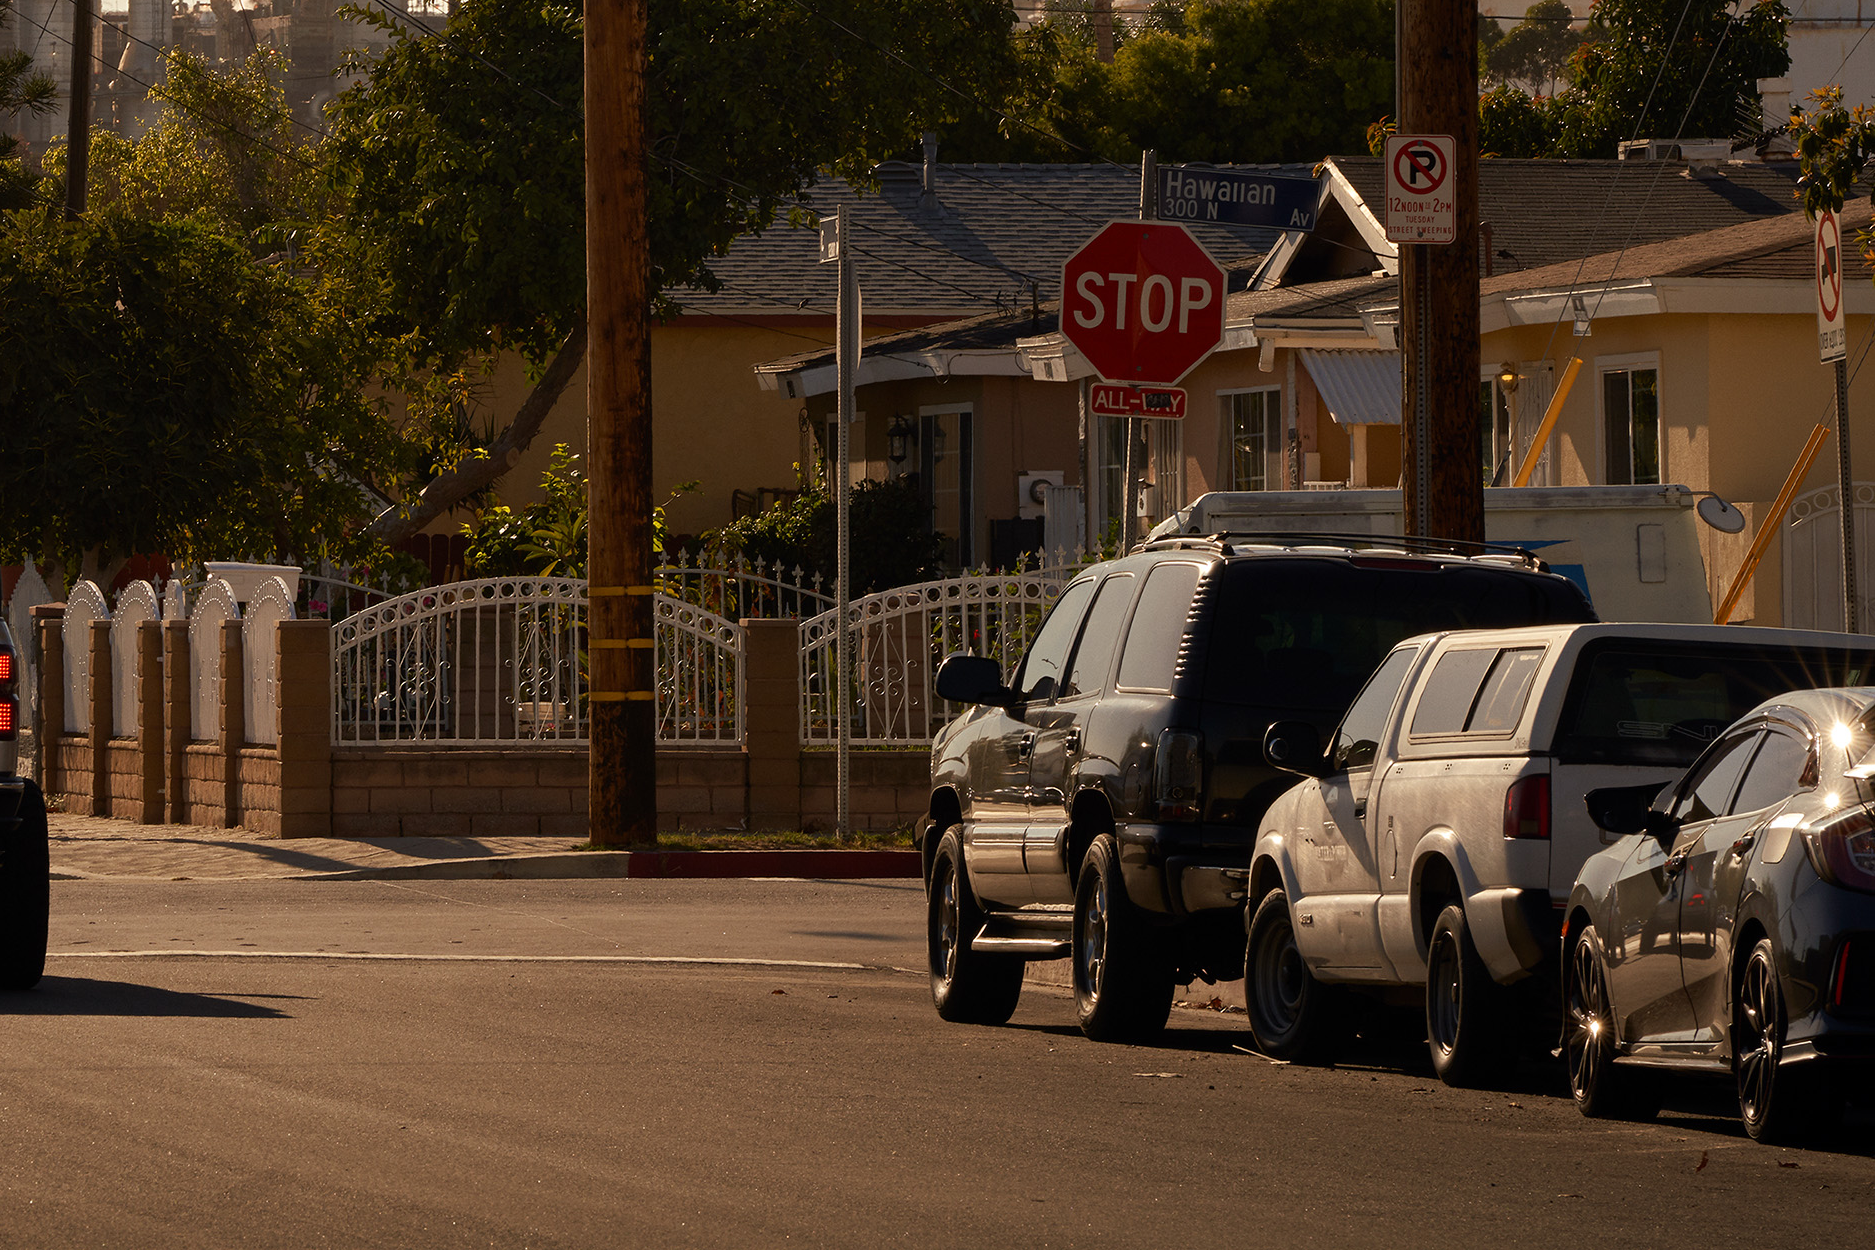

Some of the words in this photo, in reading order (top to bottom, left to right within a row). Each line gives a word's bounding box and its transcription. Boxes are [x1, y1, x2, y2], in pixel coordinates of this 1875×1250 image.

[1166, 171, 1276, 206] Hawaiian
[1164, 199, 1198, 218] 300
[1207, 202, 1218, 220] N
[1290, 208, 1310, 227] Av
[1405, 215, 1435, 223] TUESDAY
[1389, 226, 1414, 234] STREET
[1073, 271, 1213, 334] STOP
